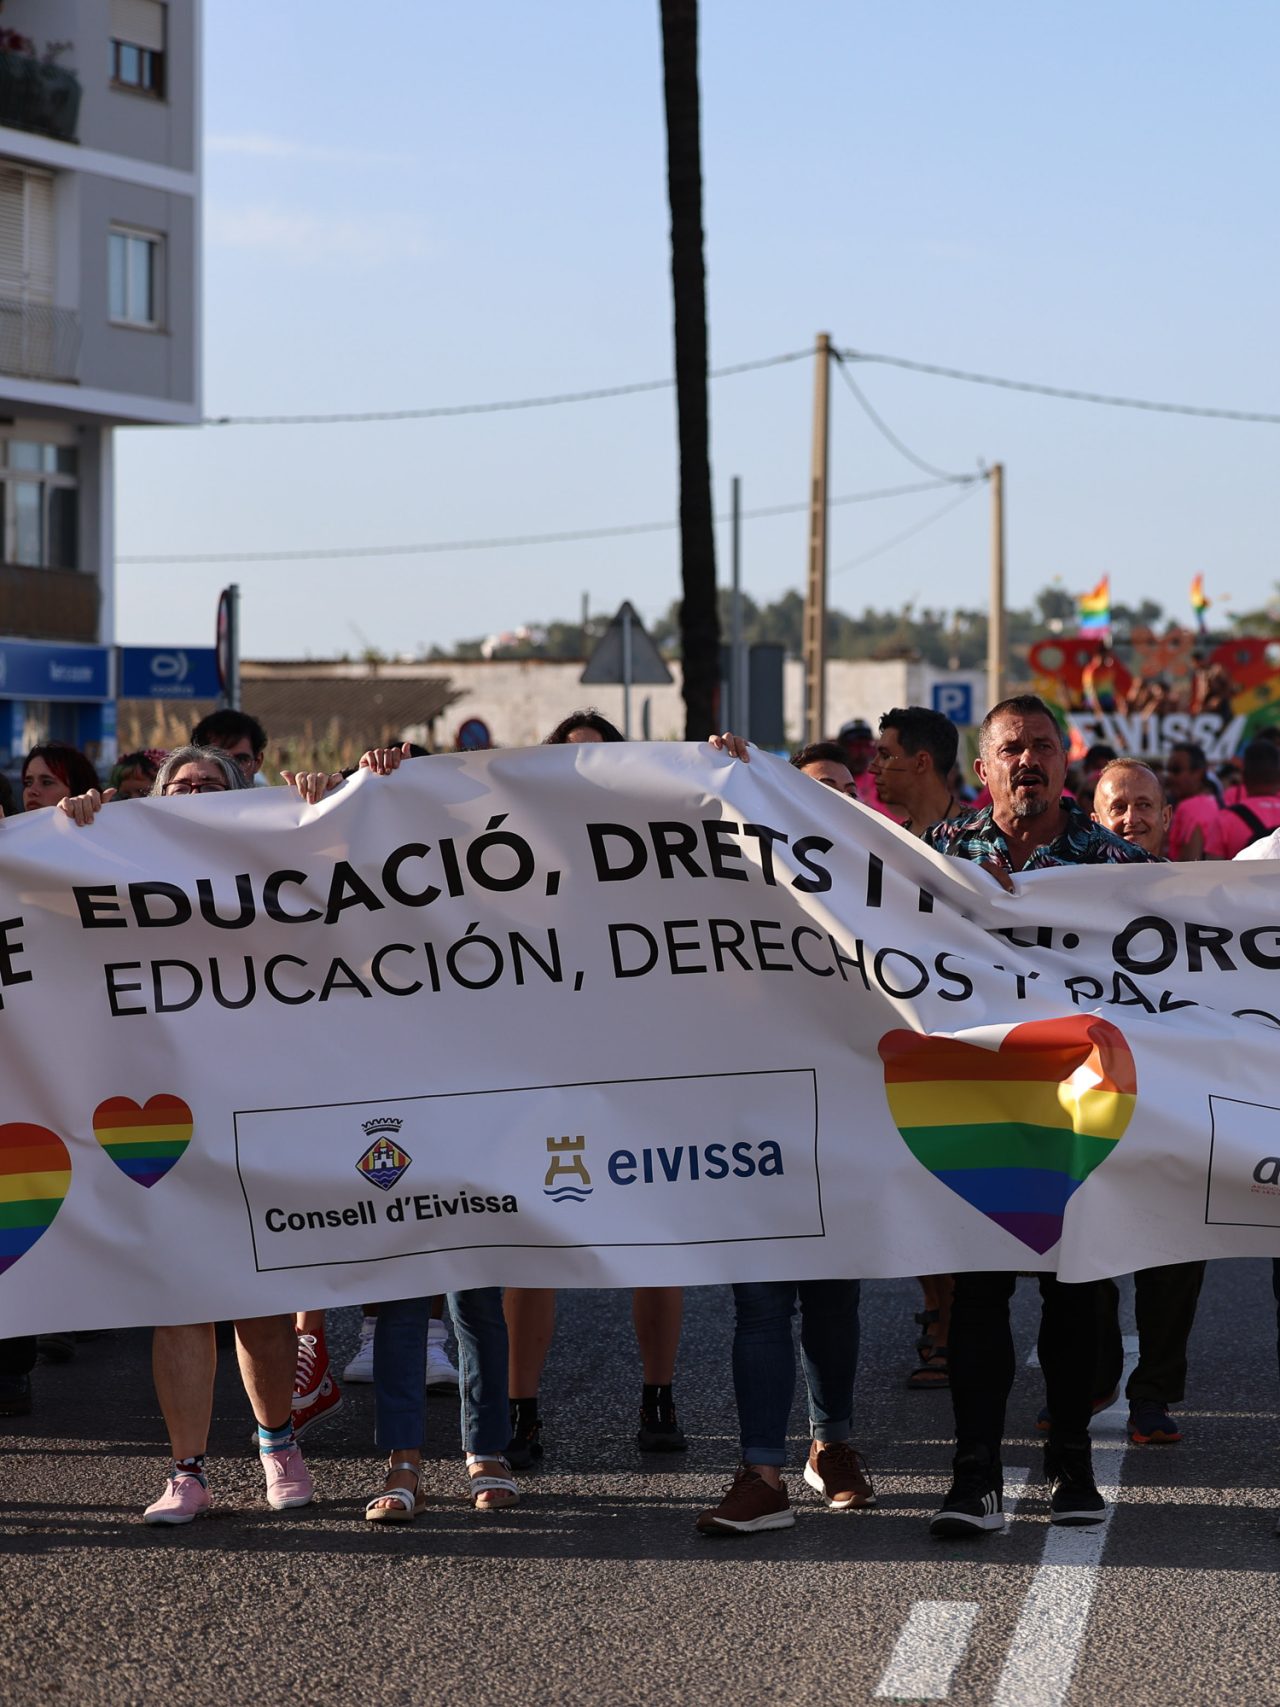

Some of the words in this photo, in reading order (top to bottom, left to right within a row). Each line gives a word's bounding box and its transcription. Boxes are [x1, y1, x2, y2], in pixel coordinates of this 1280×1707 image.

[938, 687, 965, 717] P
[72, 813, 561, 930] EDUCACIÓ,
[586, 820, 834, 894] DRETS
[866, 851, 884, 907] I
[104, 921, 586, 1017] EDUCACIÓN,
[608, 918, 974, 1002] DERECHOS
[607, 1139, 784, 1186] eivissa
[264, 1199, 377, 1233] Consell
[386, 1188, 519, 1224] d'Eivissa
